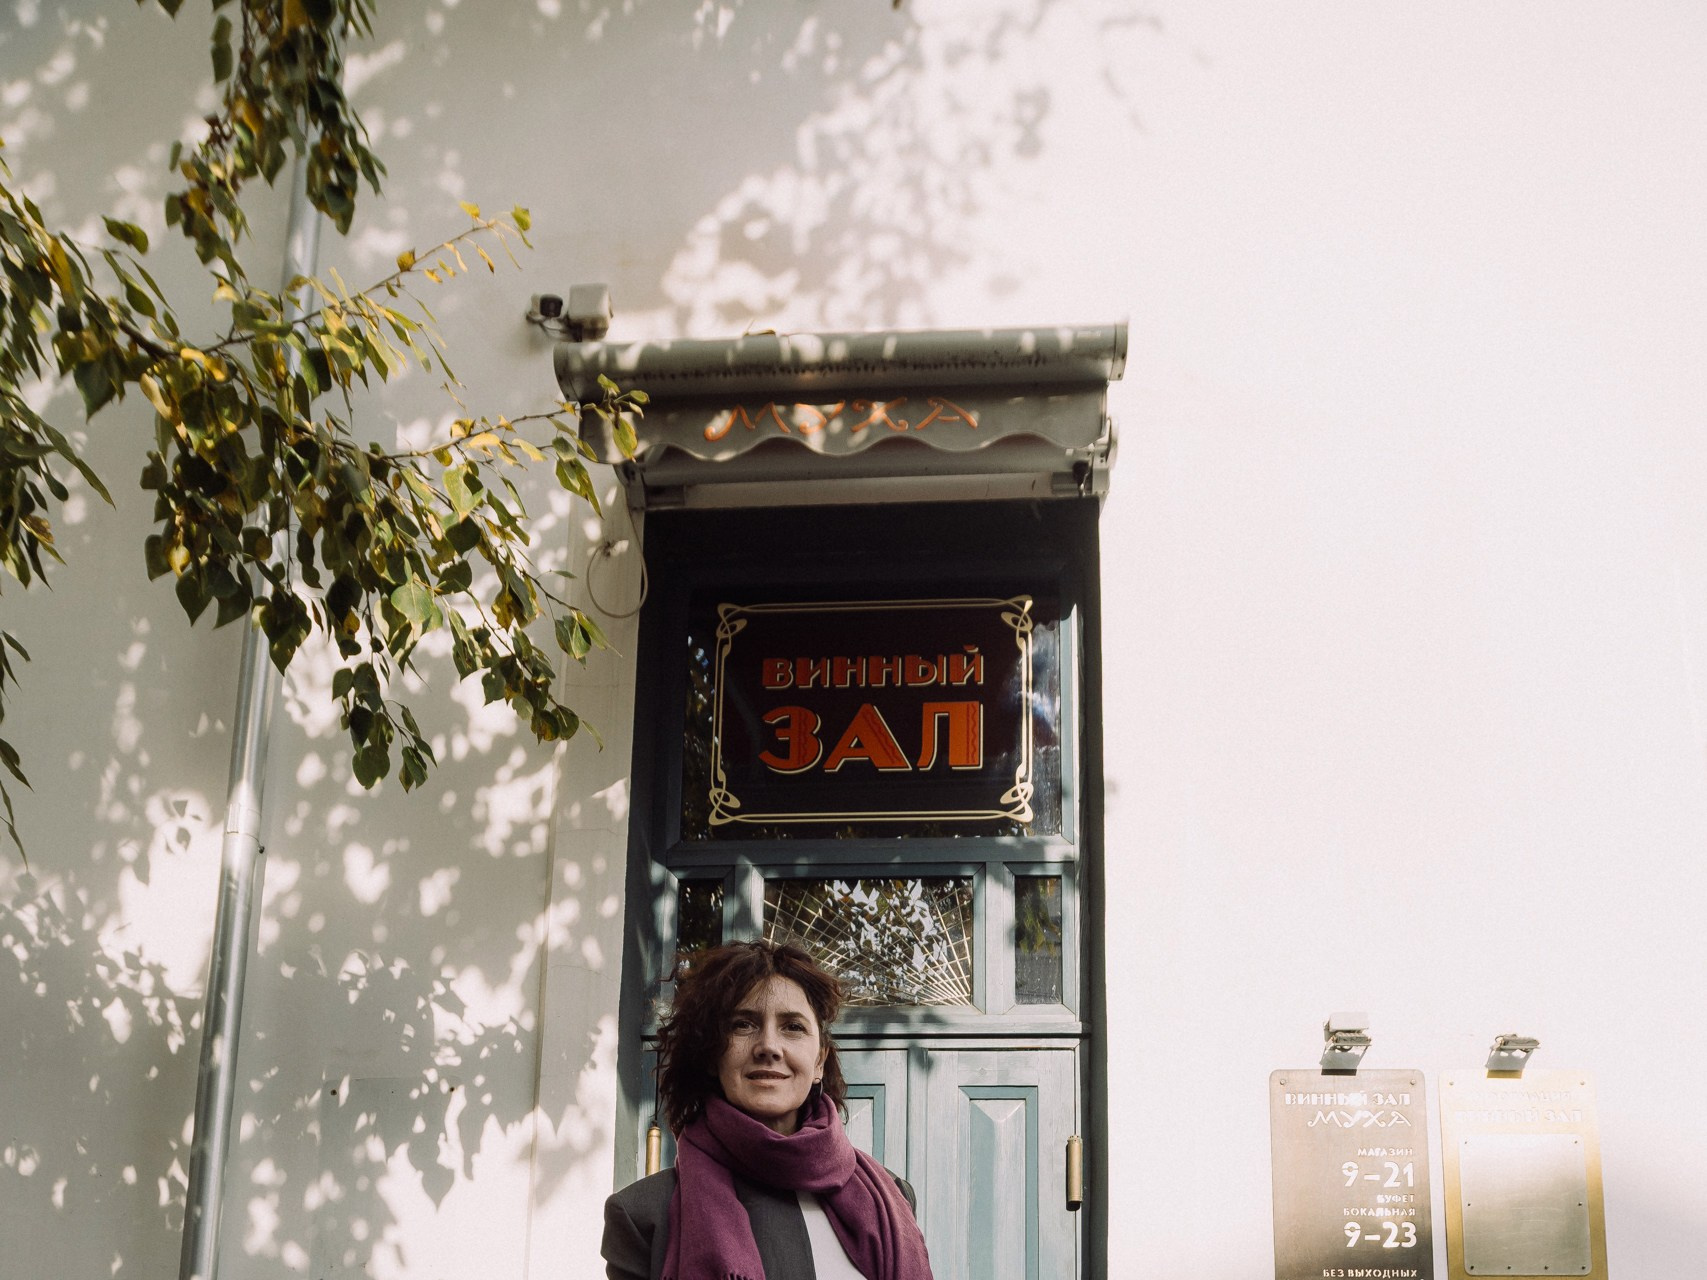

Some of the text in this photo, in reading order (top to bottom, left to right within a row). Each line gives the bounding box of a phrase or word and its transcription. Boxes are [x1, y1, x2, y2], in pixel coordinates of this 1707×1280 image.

[703, 396, 978, 442] МУХА
[762, 644, 985, 689] ВИННЫЙ
[758, 700, 985, 775] ЗАЛ
[1285, 1090, 1411, 1106] ВИННЫЙ ЗАЛ
[1307, 1110, 1412, 1128] МУХА
[1357, 1147, 1413, 1157] МАГАЗИН
[1376, 1194, 1415, 1203] БУФЕТ
[1343, 1207, 1416, 1217] БОКАЛЬНАЯ
[1322, 1268, 1418, 1279] БЕЗ ВЫХОДНЫХ
